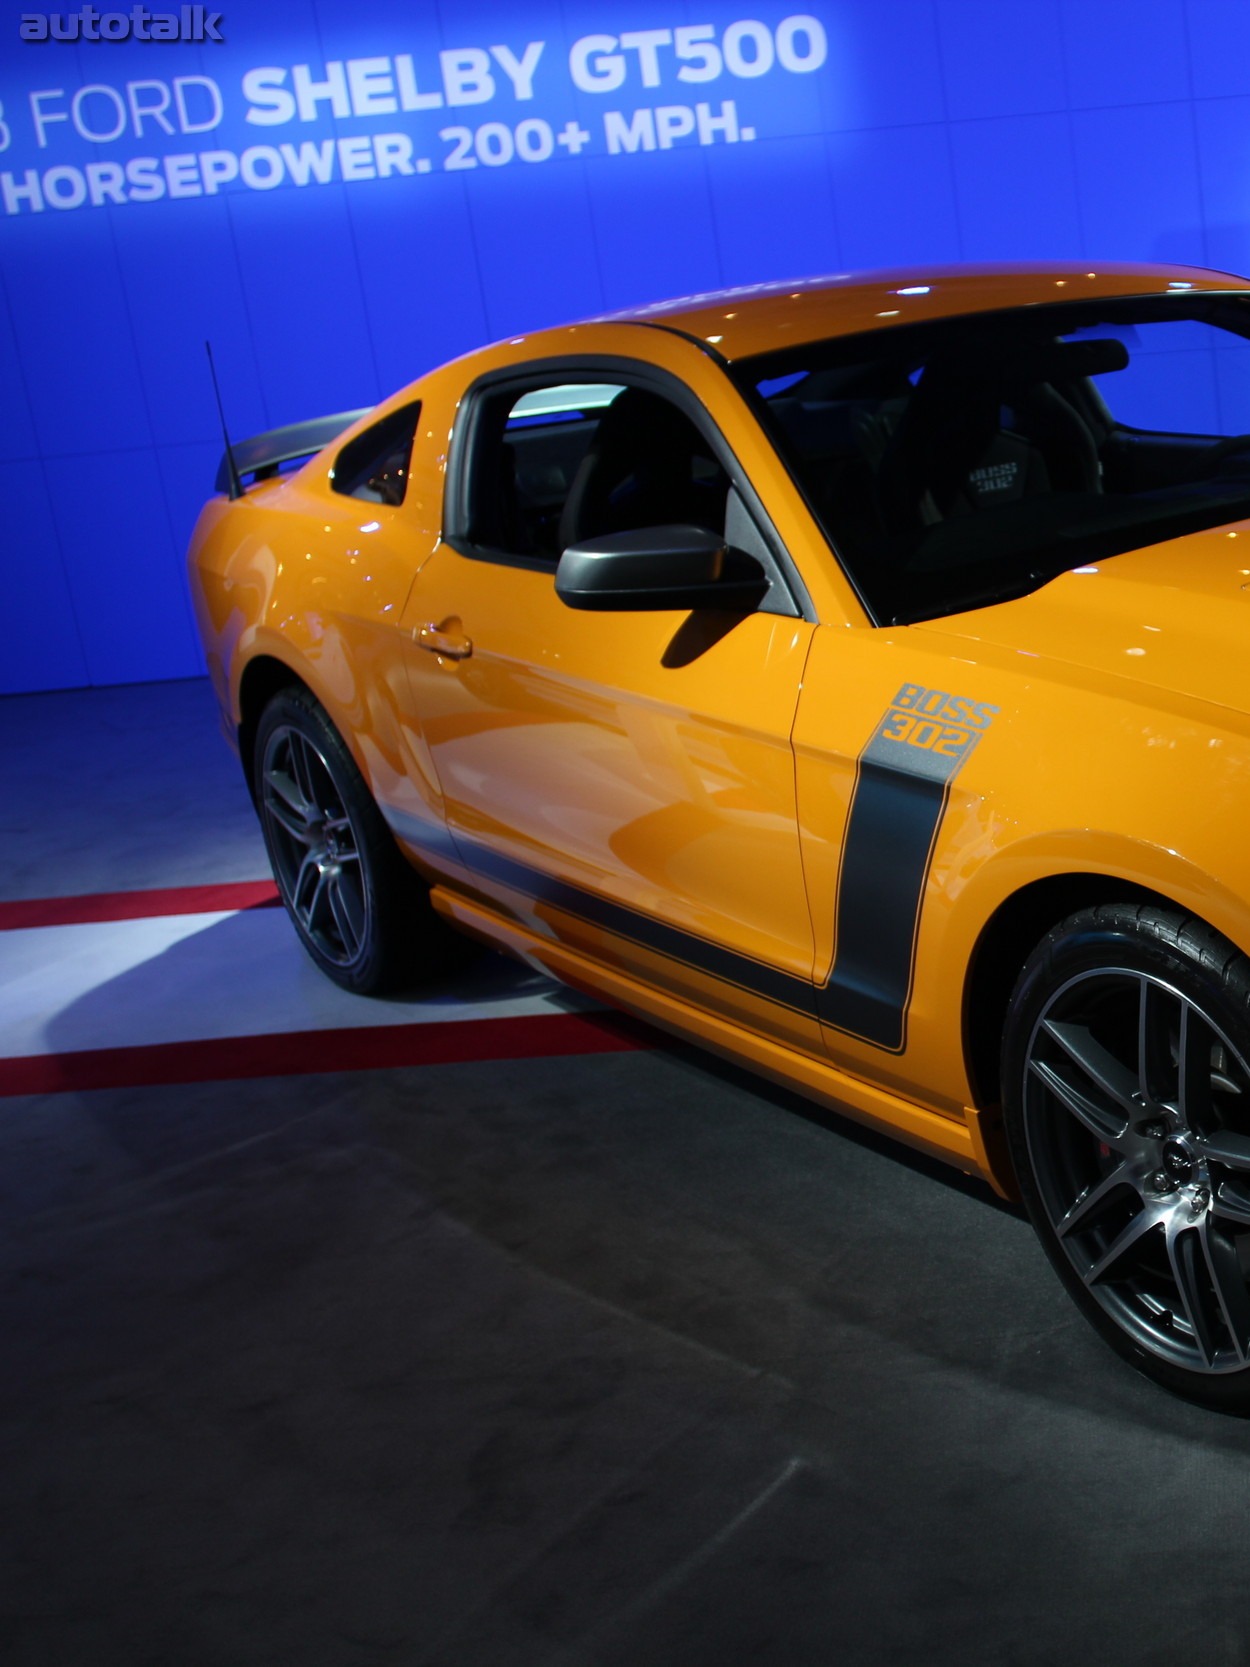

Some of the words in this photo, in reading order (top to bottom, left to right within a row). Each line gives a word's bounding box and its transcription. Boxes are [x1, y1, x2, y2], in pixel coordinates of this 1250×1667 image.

[29, 75, 224, 148] FORD
[241, 40, 546, 127] SHELBY
[568, 14, 828, 94] GT500
[0, 132, 431, 216] HORSEPOWER.
[438, 117, 591, 172] 200+
[603, 99, 757, 156] MPH.
[882, 713, 971, 757] 302
[890, 682, 1001, 730] BOSS
